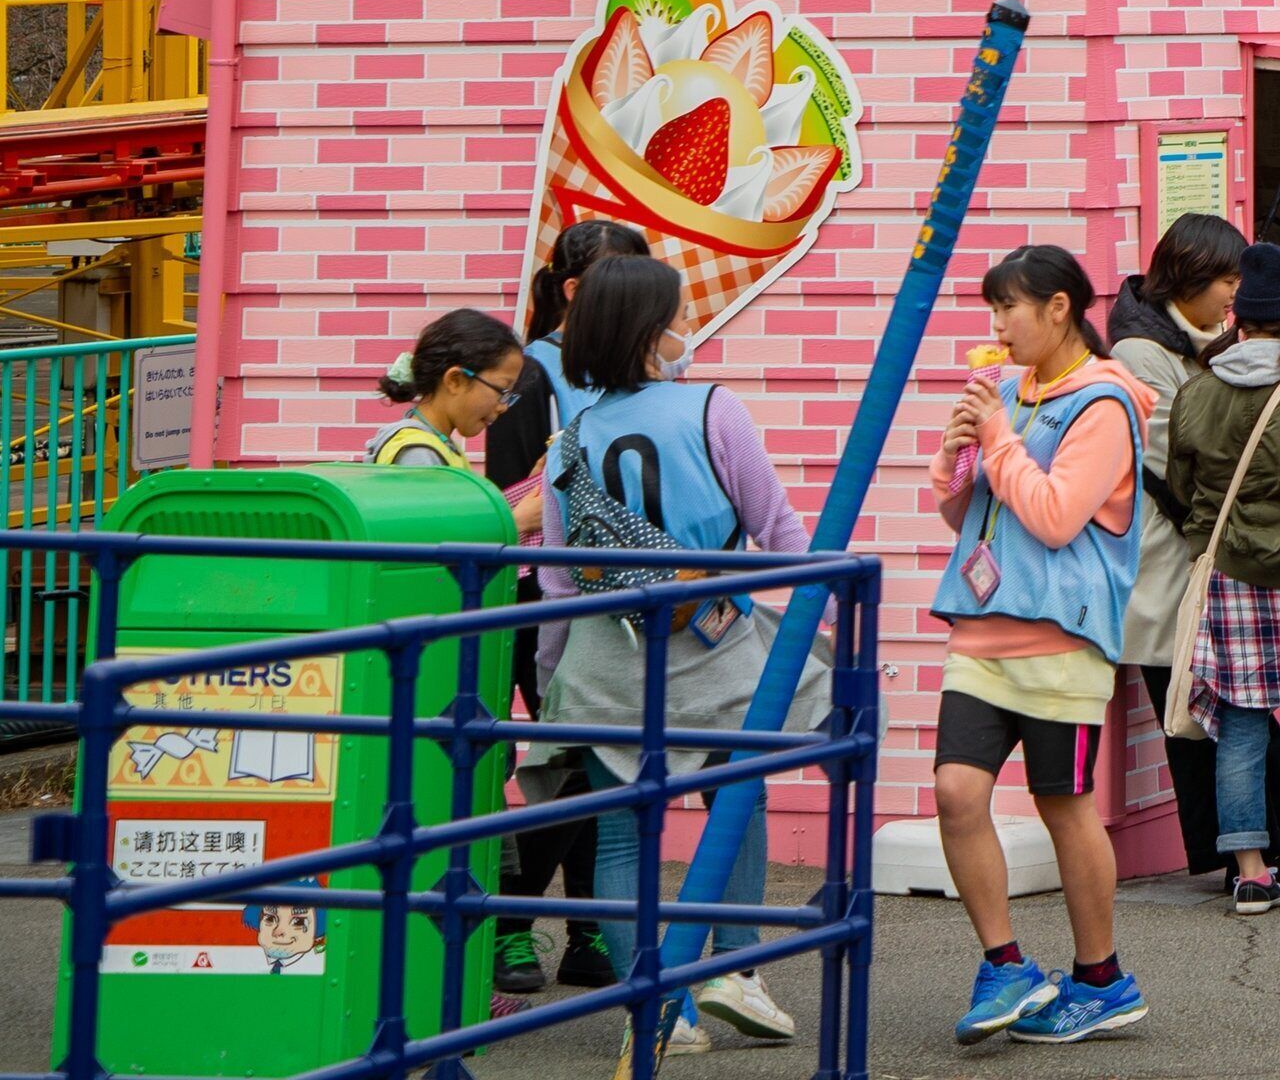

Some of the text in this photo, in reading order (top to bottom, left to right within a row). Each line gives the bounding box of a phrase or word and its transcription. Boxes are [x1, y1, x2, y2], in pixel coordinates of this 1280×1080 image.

[161, 660, 292, 688] HERS
[129, 860, 258, 879] ここに捨てて
